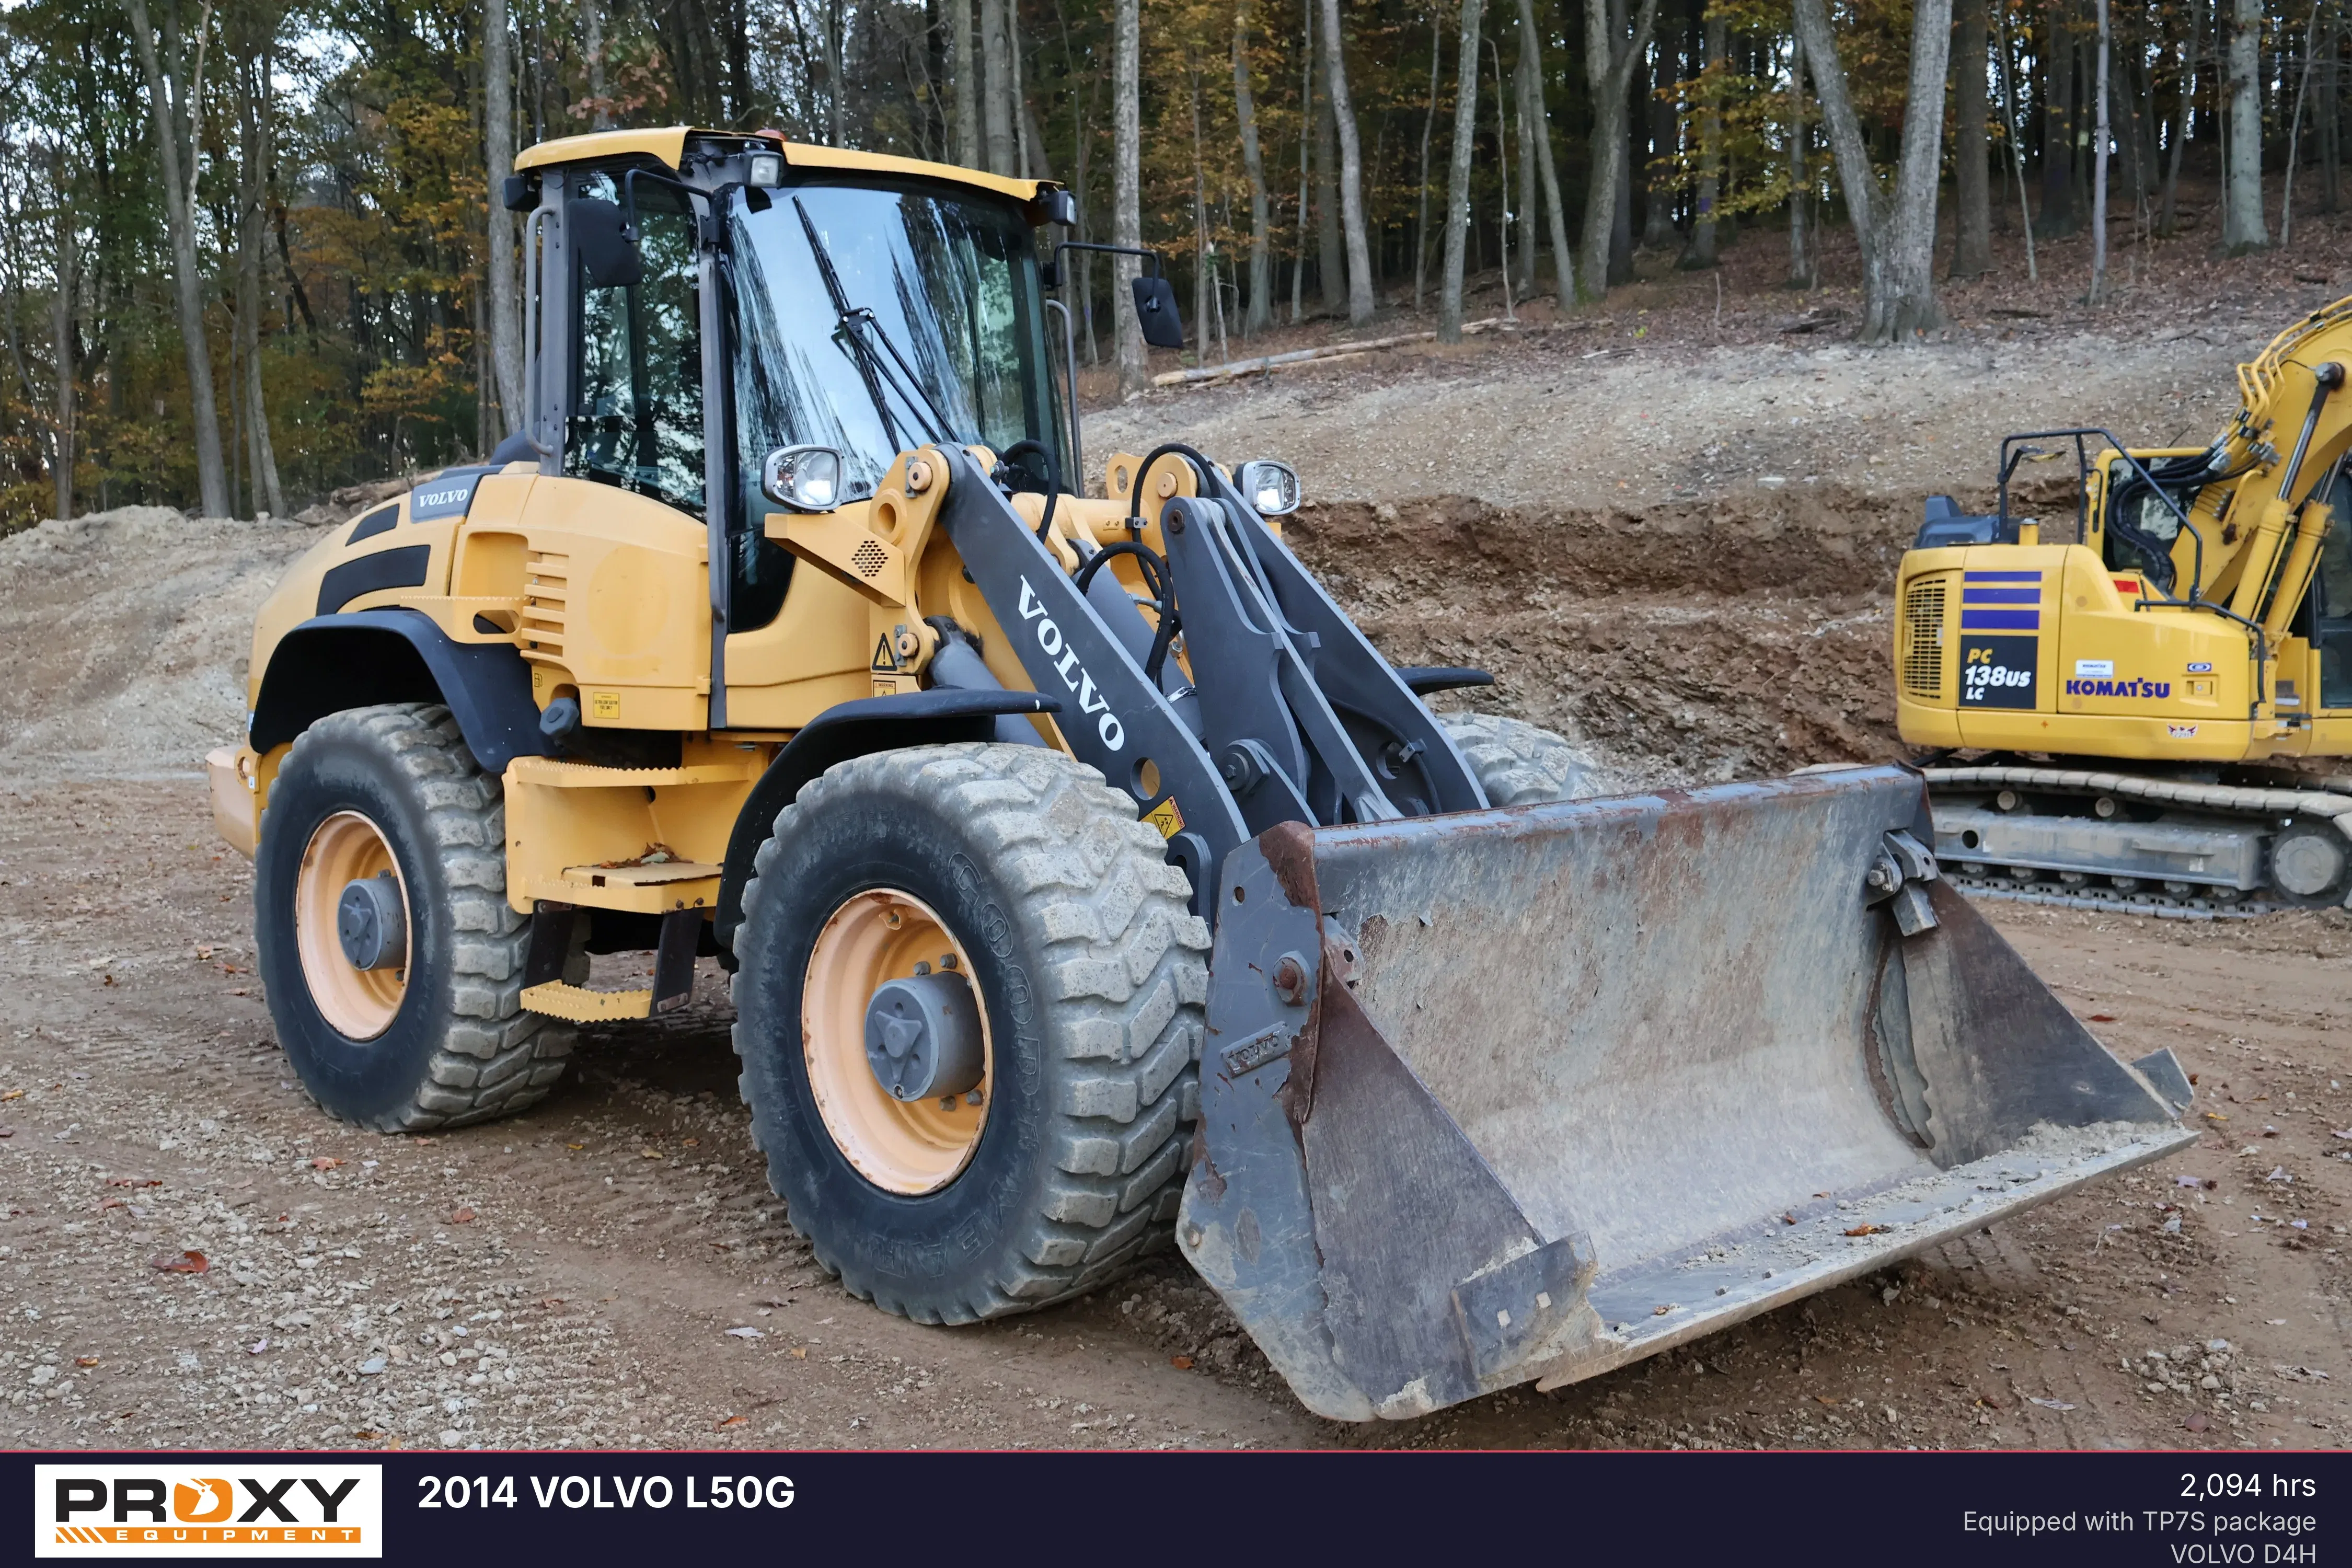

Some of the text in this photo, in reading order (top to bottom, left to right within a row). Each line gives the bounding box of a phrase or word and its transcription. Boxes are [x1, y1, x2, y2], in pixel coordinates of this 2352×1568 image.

[419, 489, 468, 508] VOLVO
[1018, 574, 1125, 752] VOLVO
[1967, 648, 1993, 664] PC
[1965, 687, 1985, 700] LC
[2066, 677, 2170, 698] KOMATSU
[1172, 804, 1184, 828] WARNING
